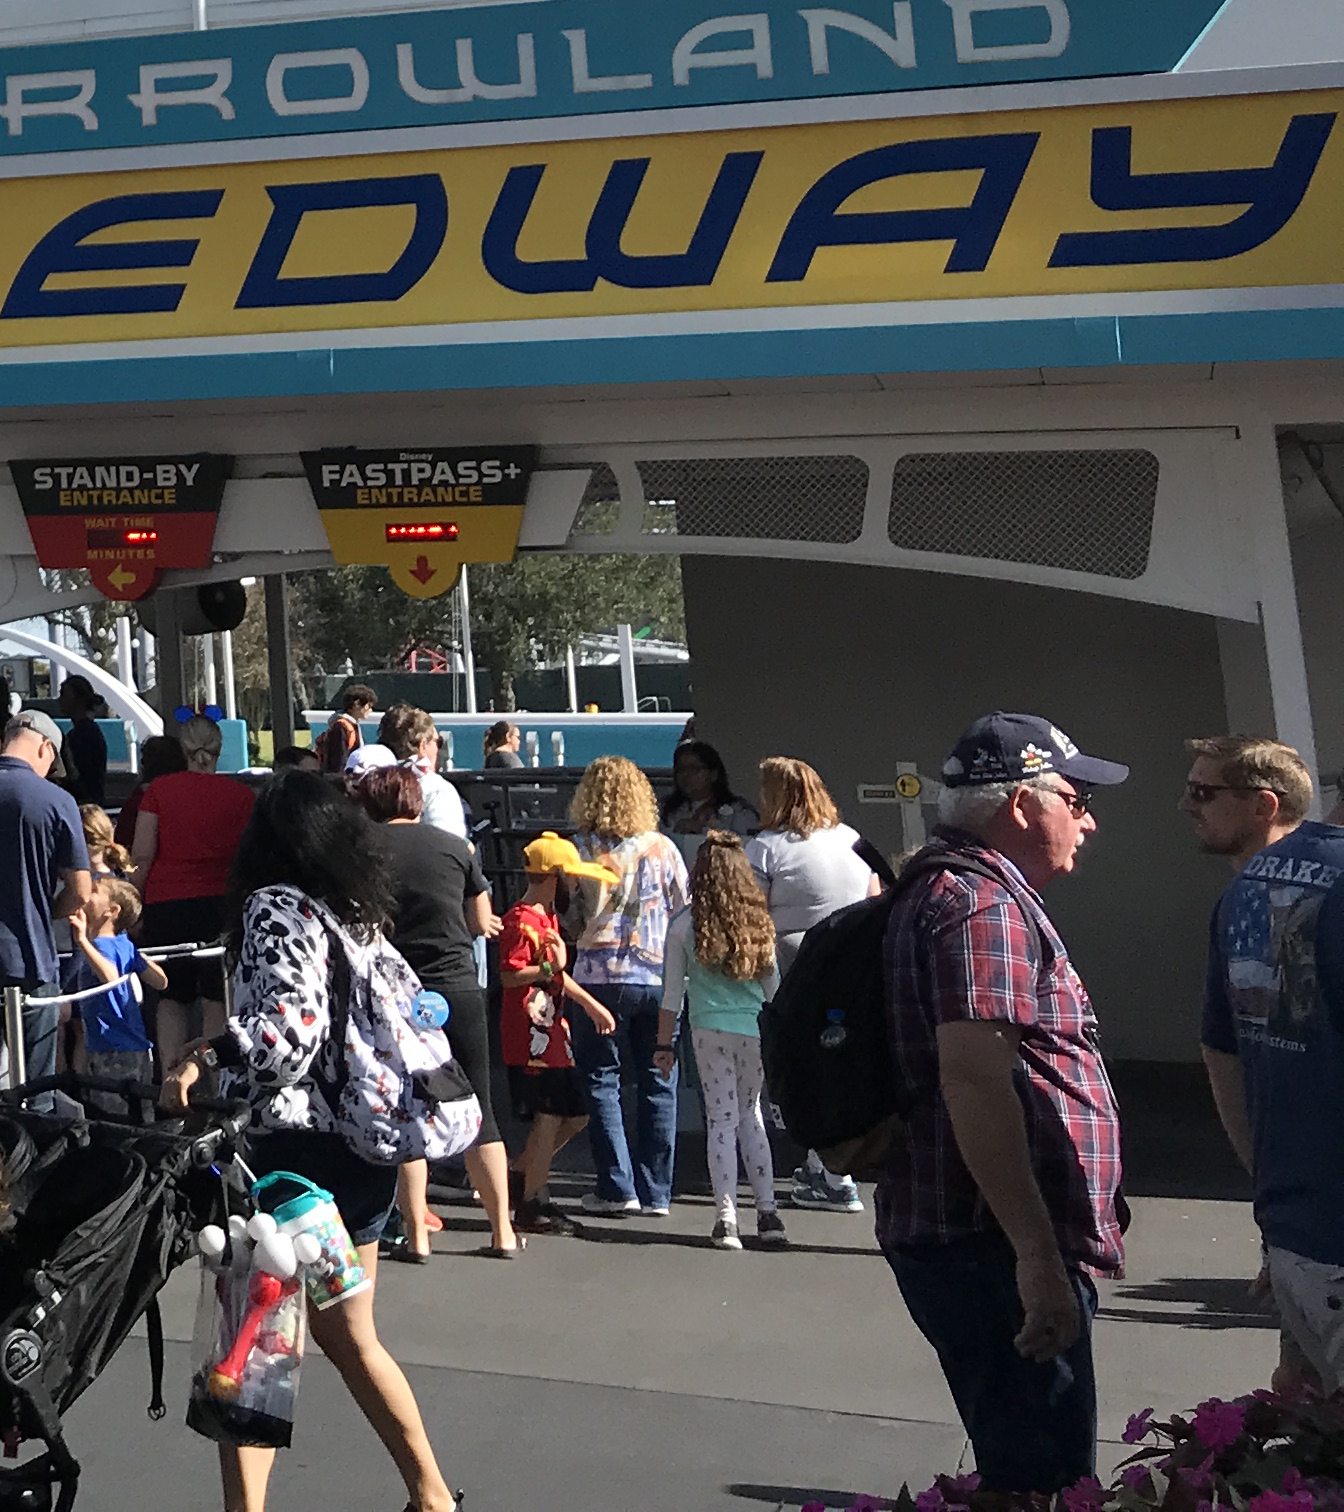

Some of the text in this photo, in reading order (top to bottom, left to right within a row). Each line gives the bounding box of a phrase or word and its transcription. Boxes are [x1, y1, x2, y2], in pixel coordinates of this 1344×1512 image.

[33, 463, 200, 490] STAND-BY
[321, 460, 522, 488] FASTPASS+
[59, 488, 177, 507] ENTRANCE
[356, 485, 483, 505] ENTRANCE
[84, 516, 154, 528] WAIT TIME
[87, 549, 155, 560] MINUTES
[1243, 854, 1343, 888] DRAKE
